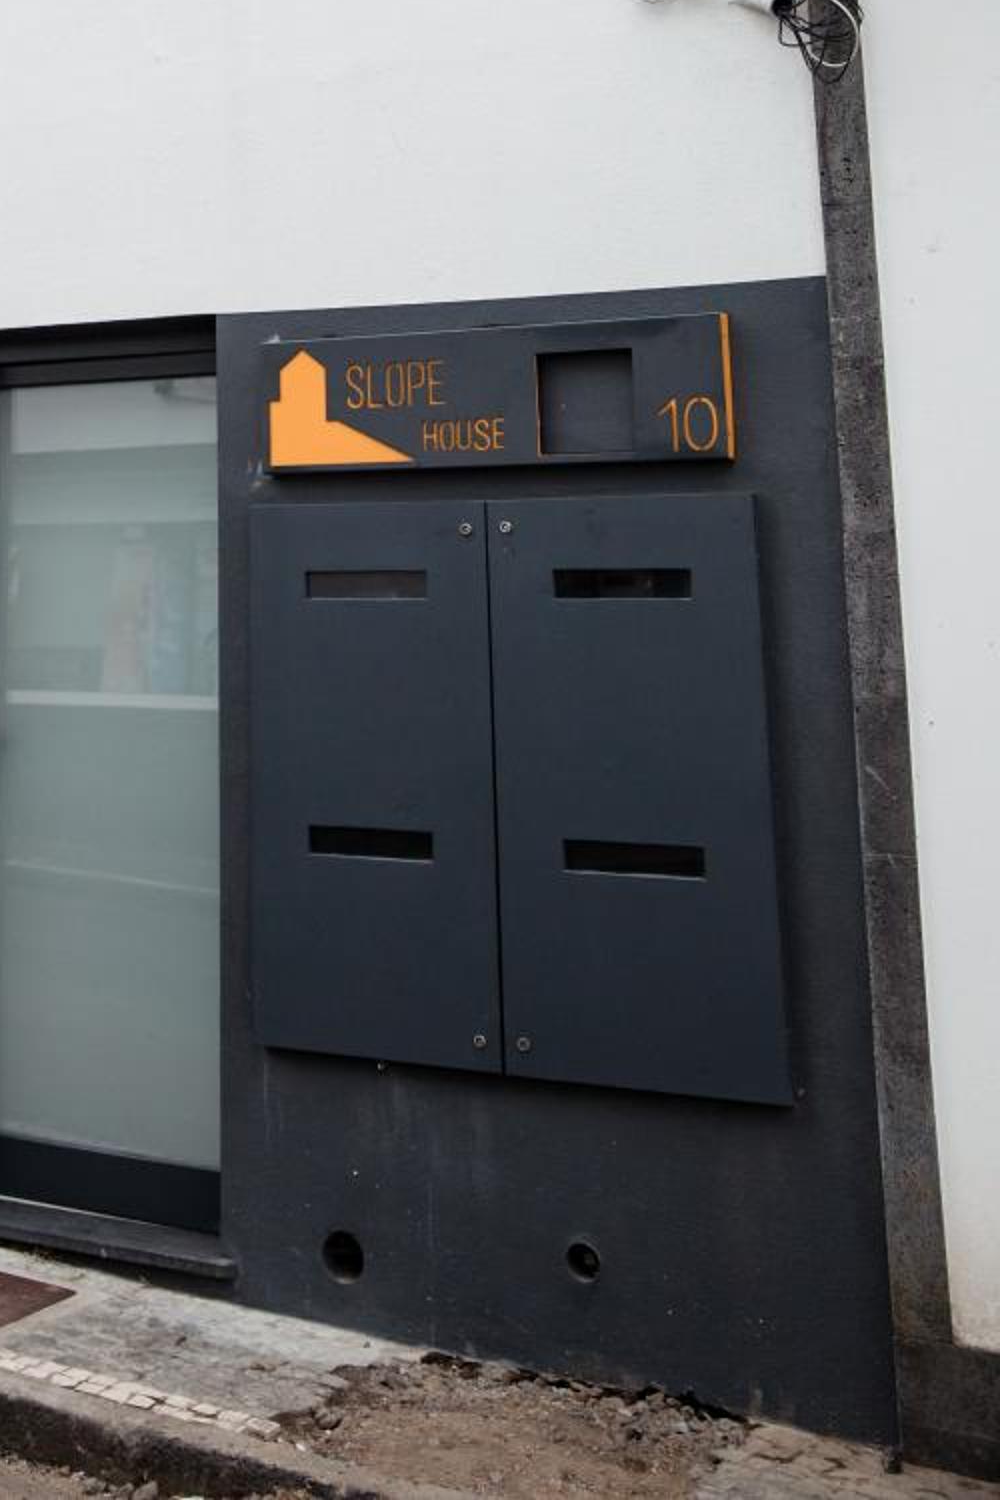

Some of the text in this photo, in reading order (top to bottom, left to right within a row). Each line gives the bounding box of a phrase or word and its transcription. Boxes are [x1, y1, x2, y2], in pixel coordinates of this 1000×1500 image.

[346, 360, 444, 409] SLOPE
[422, 417, 505, 452] HOUSE
[656, 393, 719, 453] 10
